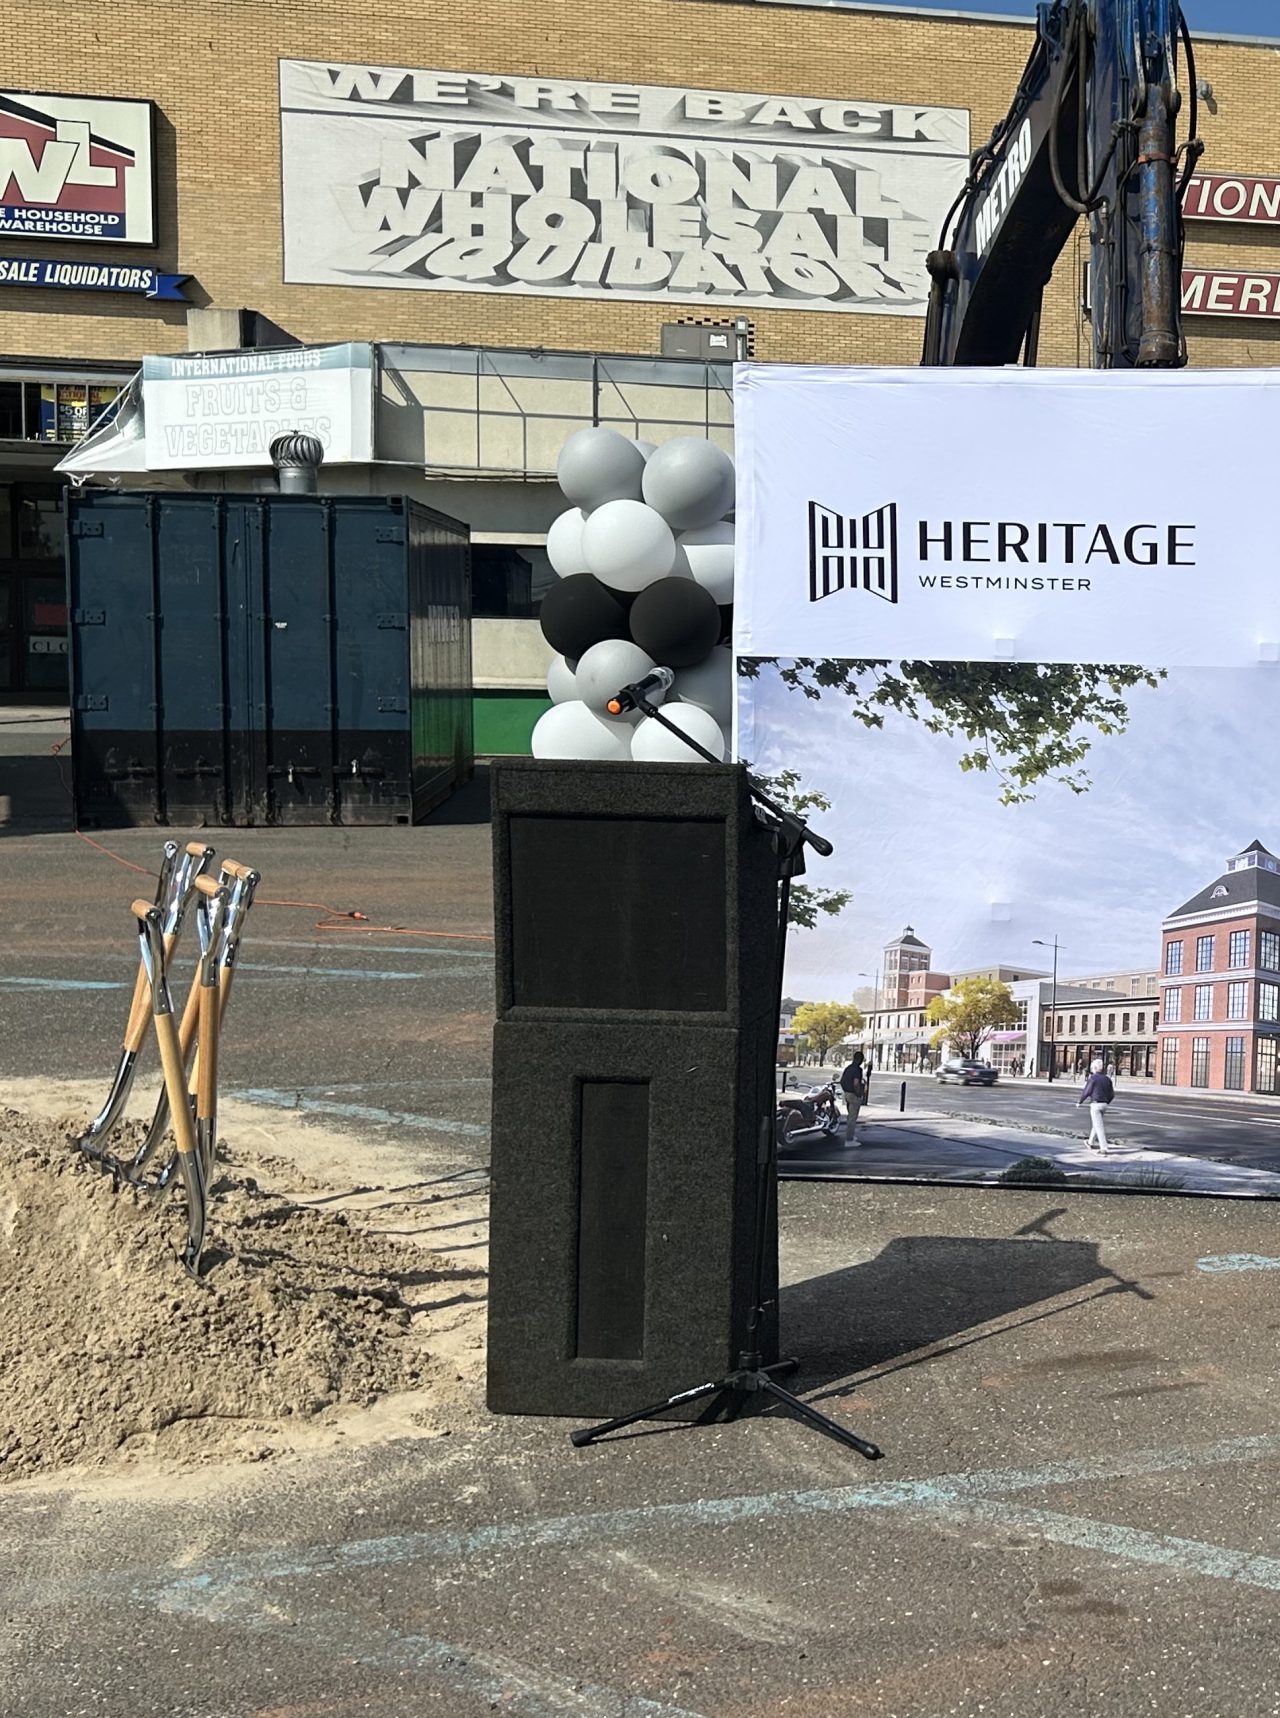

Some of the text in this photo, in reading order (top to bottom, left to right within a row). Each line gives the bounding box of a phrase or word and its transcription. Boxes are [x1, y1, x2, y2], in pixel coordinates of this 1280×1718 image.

[304, 67, 957, 142] WE'RE BACK
[380, 130, 904, 219] NATIONAL
[975, 117, 1032, 261] METRO
[0, 219, 103, 236] WAREHOUSE
[14, 208, 120, 225] HOUSEHOLD
[329, 183, 934, 263] WHOLESALE
[44, 263, 153, 290] LIQUIDATORS
[316, 233, 931, 301] LIQUIDATORS
[171, 349, 321, 377] INTERNATIONAL FOODS
[185, 377, 307, 418] FRUITS &
[918, 520, 1197, 566] HERITAGE
[918, 575, 1092, 592] WESTMINSTER
